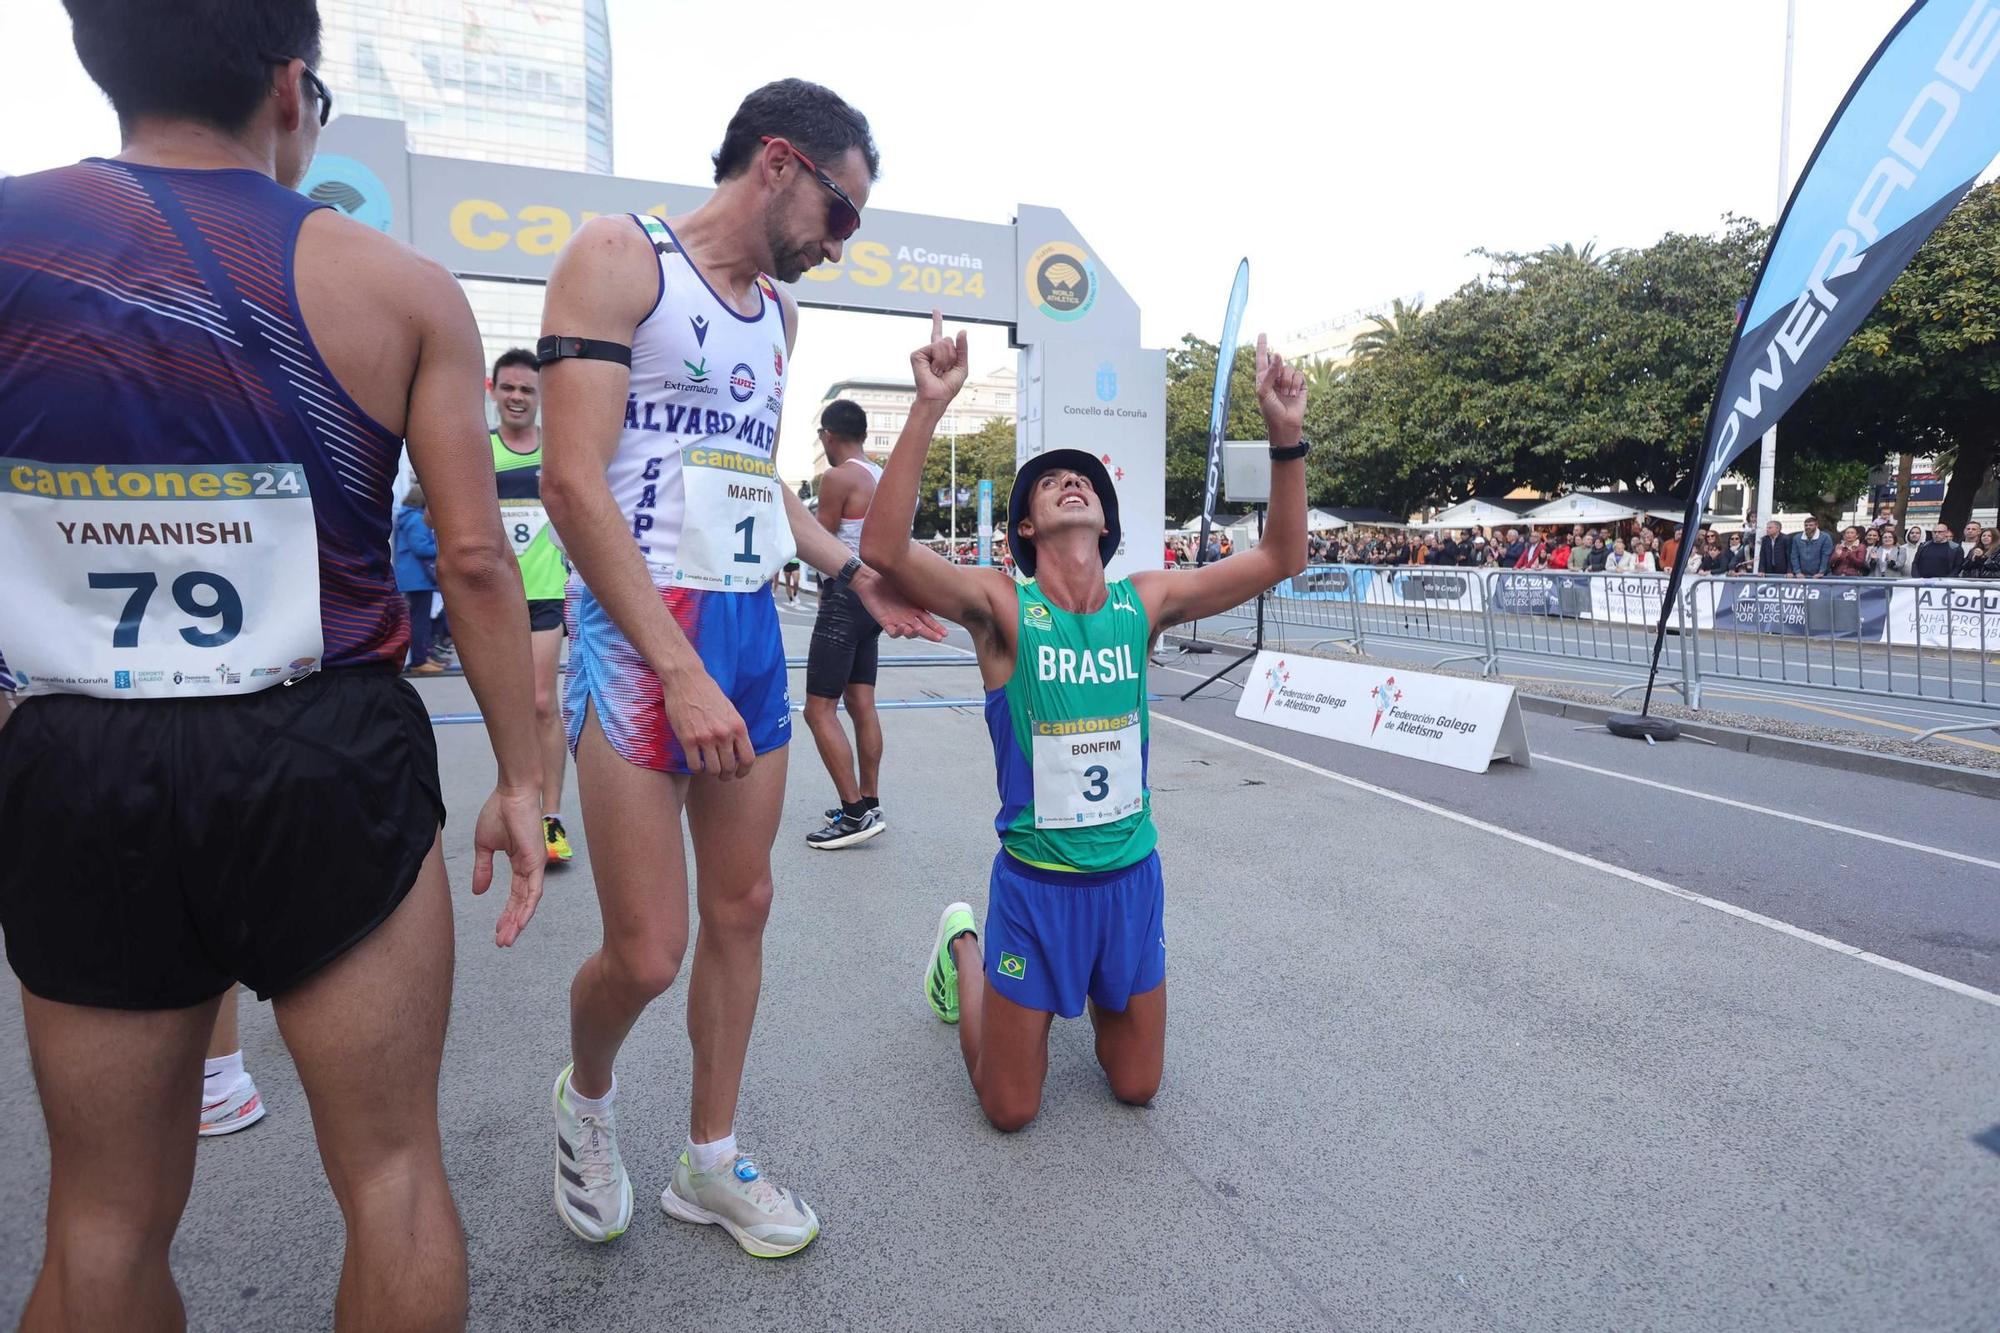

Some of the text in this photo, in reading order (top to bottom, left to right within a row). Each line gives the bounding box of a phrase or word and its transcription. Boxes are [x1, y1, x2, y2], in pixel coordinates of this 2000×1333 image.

[897, 263, 986, 299] 2024
[1046, 295, 1080, 304] ATHLETICS
[664, 380, 719, 395] Extremadura
[623, 391, 737, 435] ÁLVARO
[1063, 405, 1148, 419] Concello da Coruña
[690, 449, 774, 477] cantone
[727, 484, 774, 504] MARTÍN
[56, 521, 253, 545] YAMANISHI
[515, 523, 530, 543] 8
[734, 515, 761, 564] 1
[1605, 580, 1614, 593] A
[1738, 583, 1820, 600] A Coruña
[87, 570, 244, 648] 79
[1919, 590, 1998, 610] A Coru
[1038, 644, 1139, 685] BRASIL
[66, 676, 76, 684] da
[78, 676, 109, 685] Coruña
[1278, 685, 1347, 709] Federación Galega
[1283, 699, 1320, 714] Atletismo
[1385, 720, 1443, 740] de Atletismo
[1389, 706, 1477, 734] Federación Galega
[1072, 740, 1121, 756] BONFIM
[1082, 765, 1110, 802] 3
